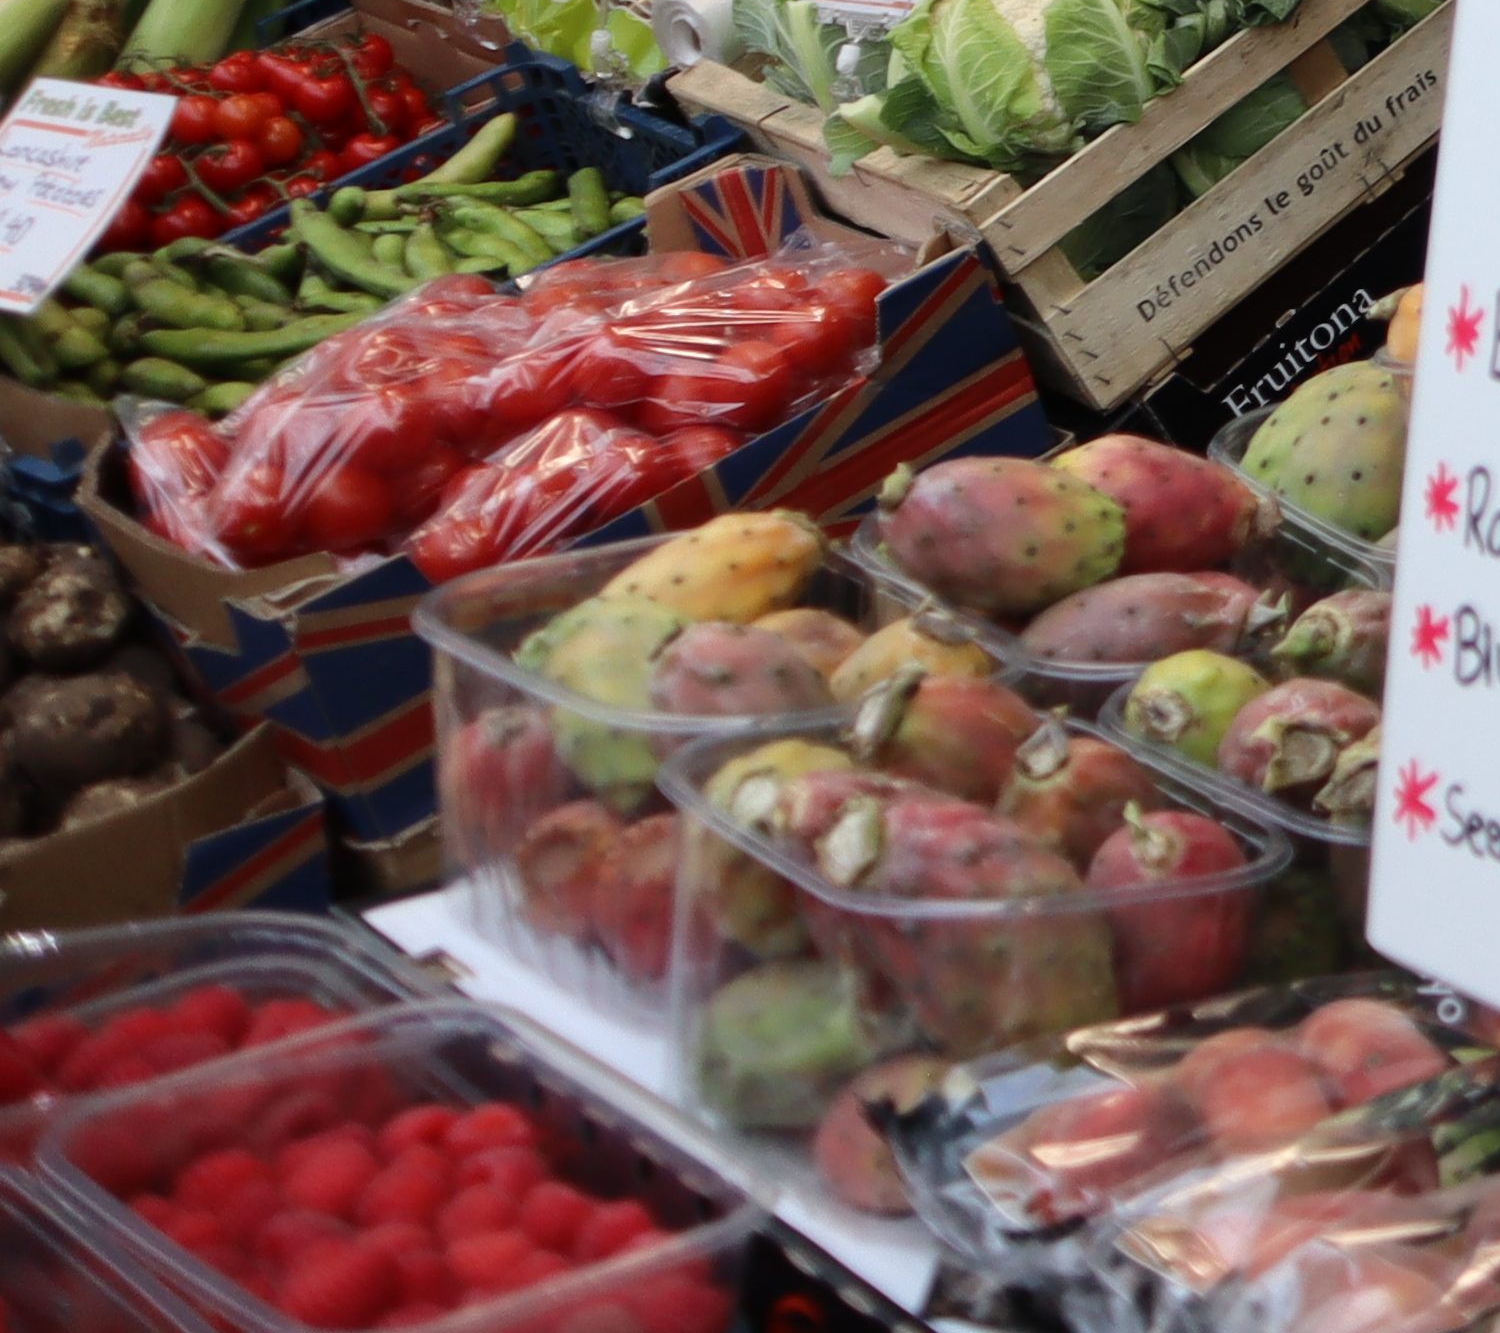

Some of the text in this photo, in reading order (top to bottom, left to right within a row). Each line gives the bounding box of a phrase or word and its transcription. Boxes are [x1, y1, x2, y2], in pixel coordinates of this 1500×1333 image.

[1135, 65, 1439, 325] Défendons le goût du frais
[1219, 282, 1378, 420] Fruitona
